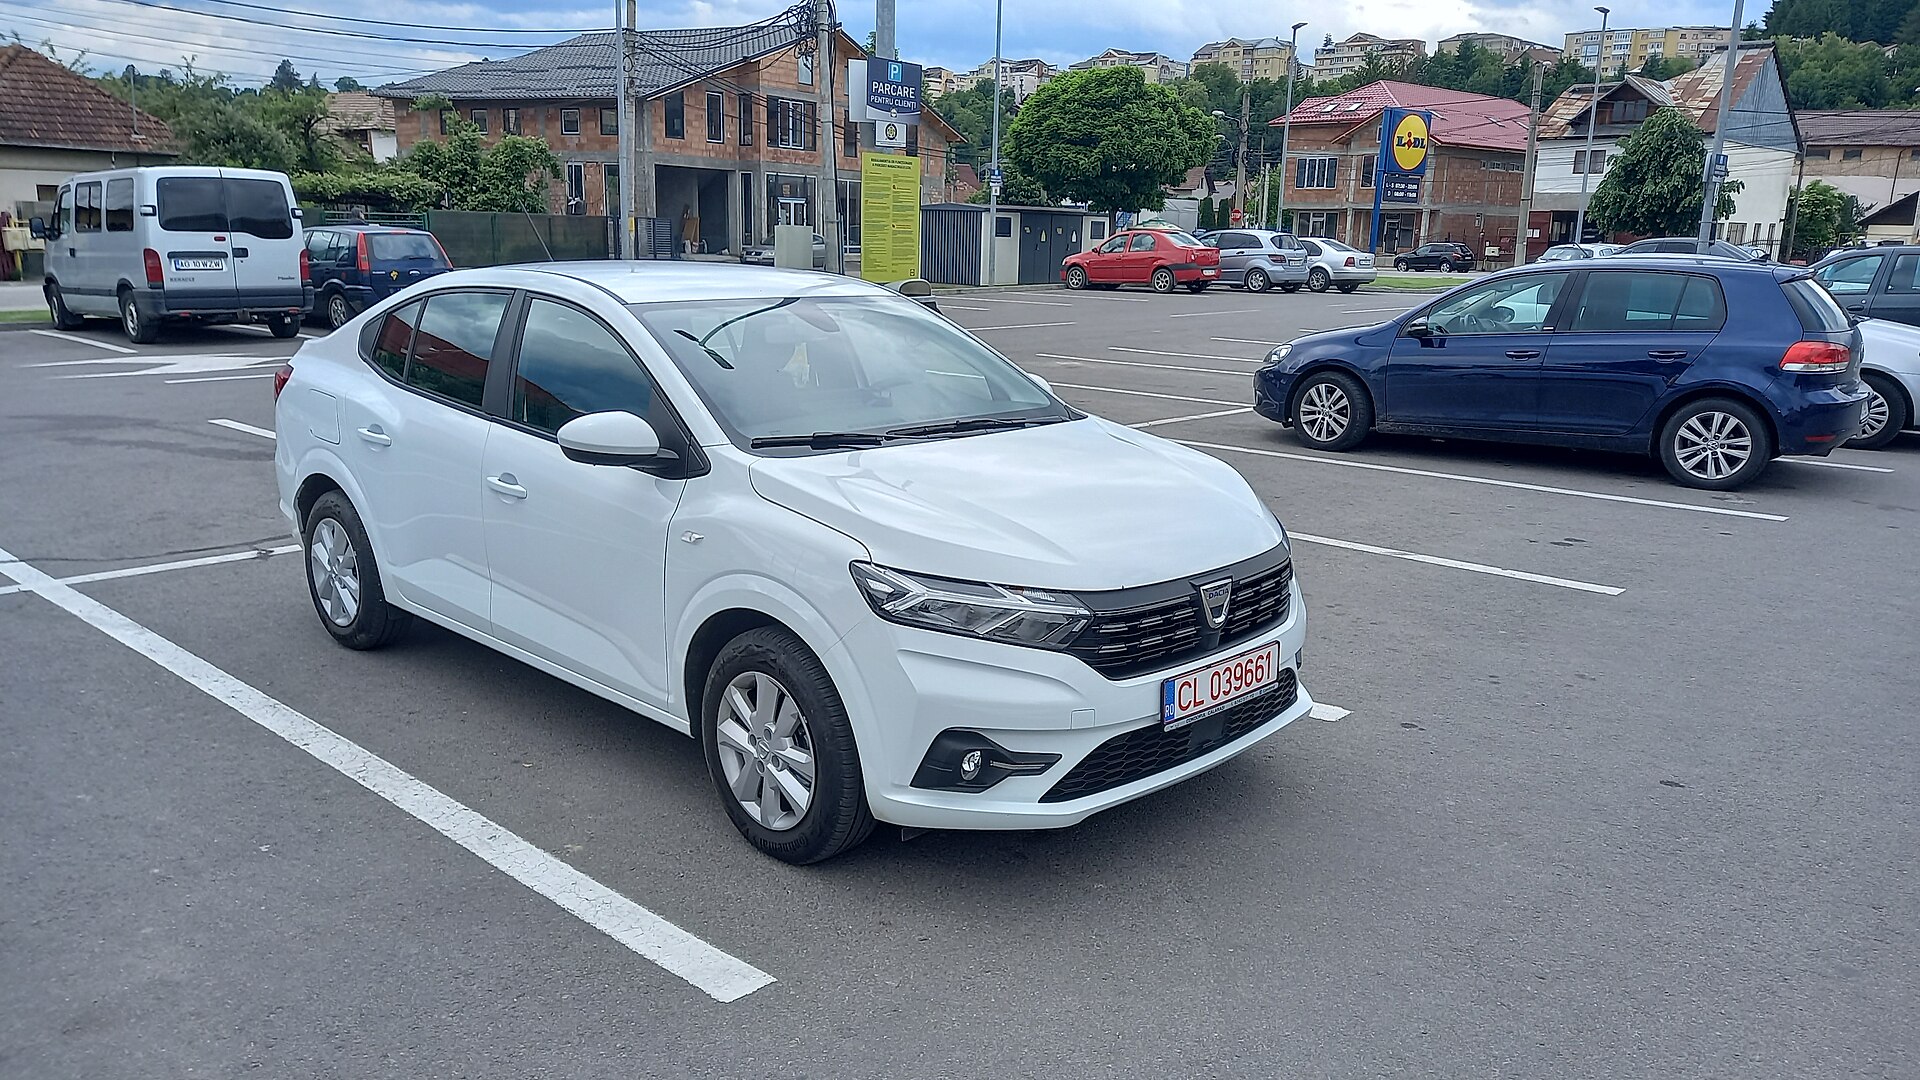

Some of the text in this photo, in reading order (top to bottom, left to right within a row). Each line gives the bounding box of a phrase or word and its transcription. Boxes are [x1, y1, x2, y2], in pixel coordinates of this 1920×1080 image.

[890, 64, 899, 80] P
[872, 81, 916, 99] PARCARE
[870, 95, 894, 106] PENTRU
[1209, 587, 1229, 600] DACIA
[1178, 650, 1272, 711] CL 039661
[1165, 703, 1175, 718] RO
